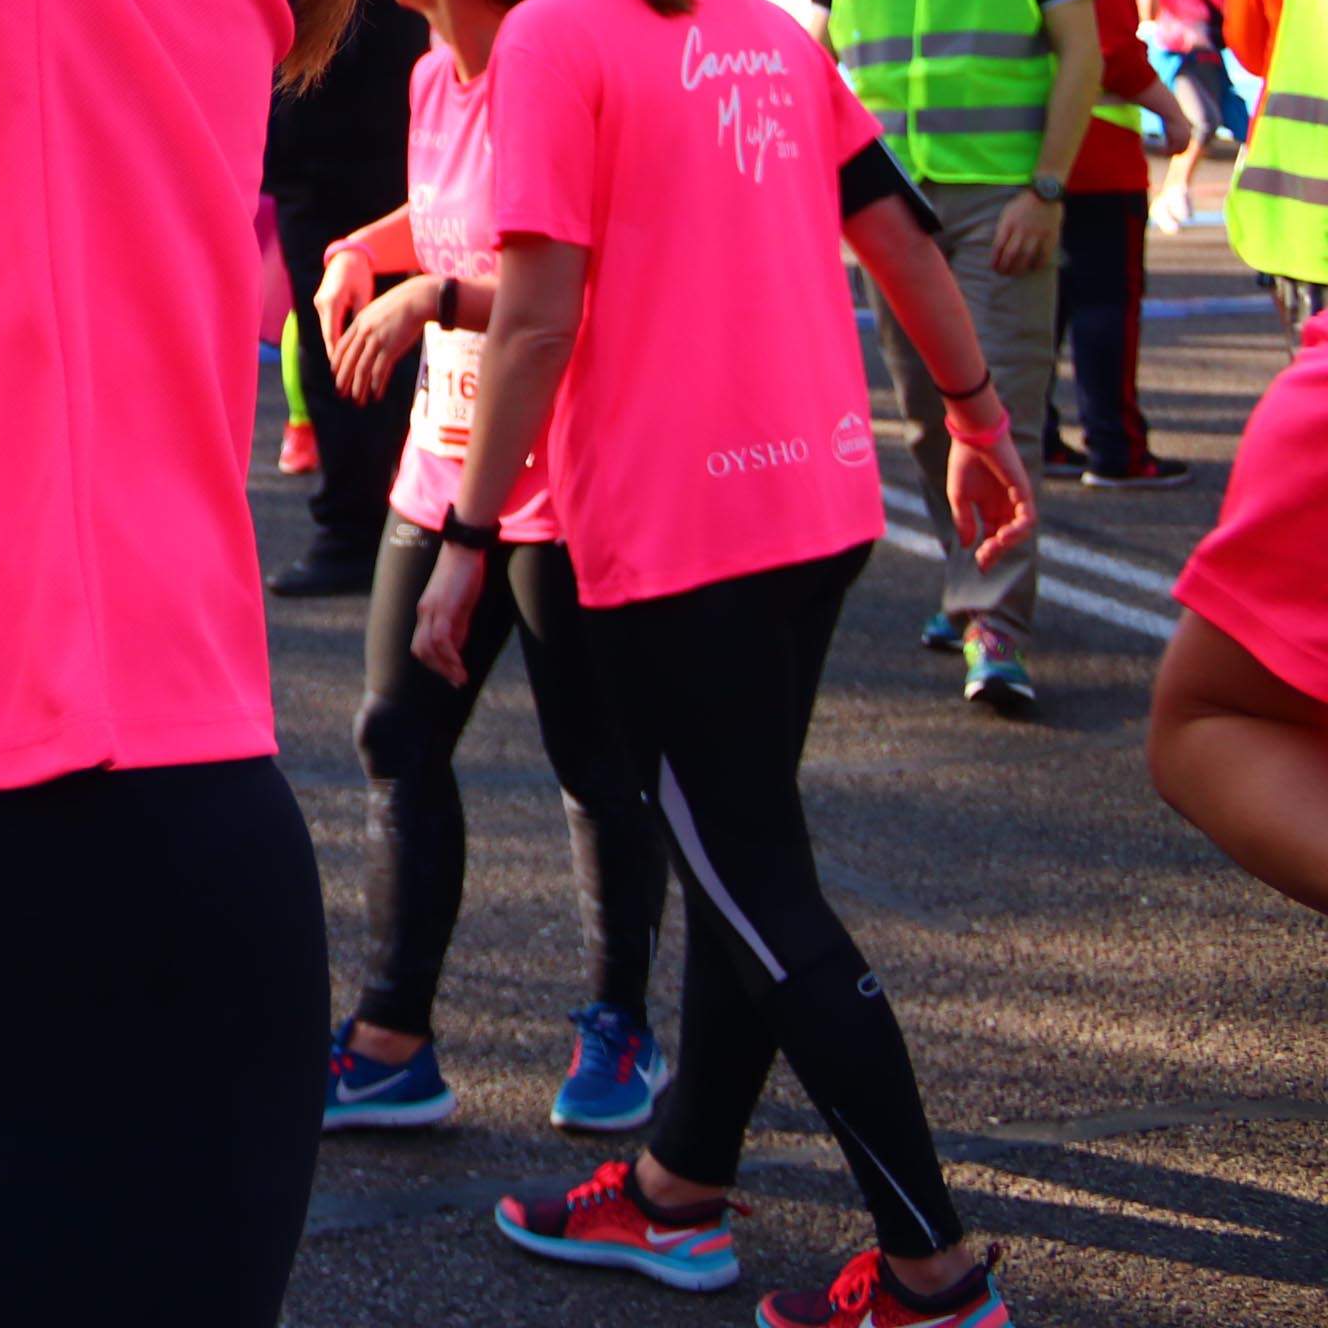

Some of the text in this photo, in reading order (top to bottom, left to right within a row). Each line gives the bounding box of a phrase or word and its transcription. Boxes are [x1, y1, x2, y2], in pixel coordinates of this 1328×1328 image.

[681, 25, 788, 90] Carrera
[445, 371, 479, 401] 16
[706, 437, 811, 478] OYSHO
